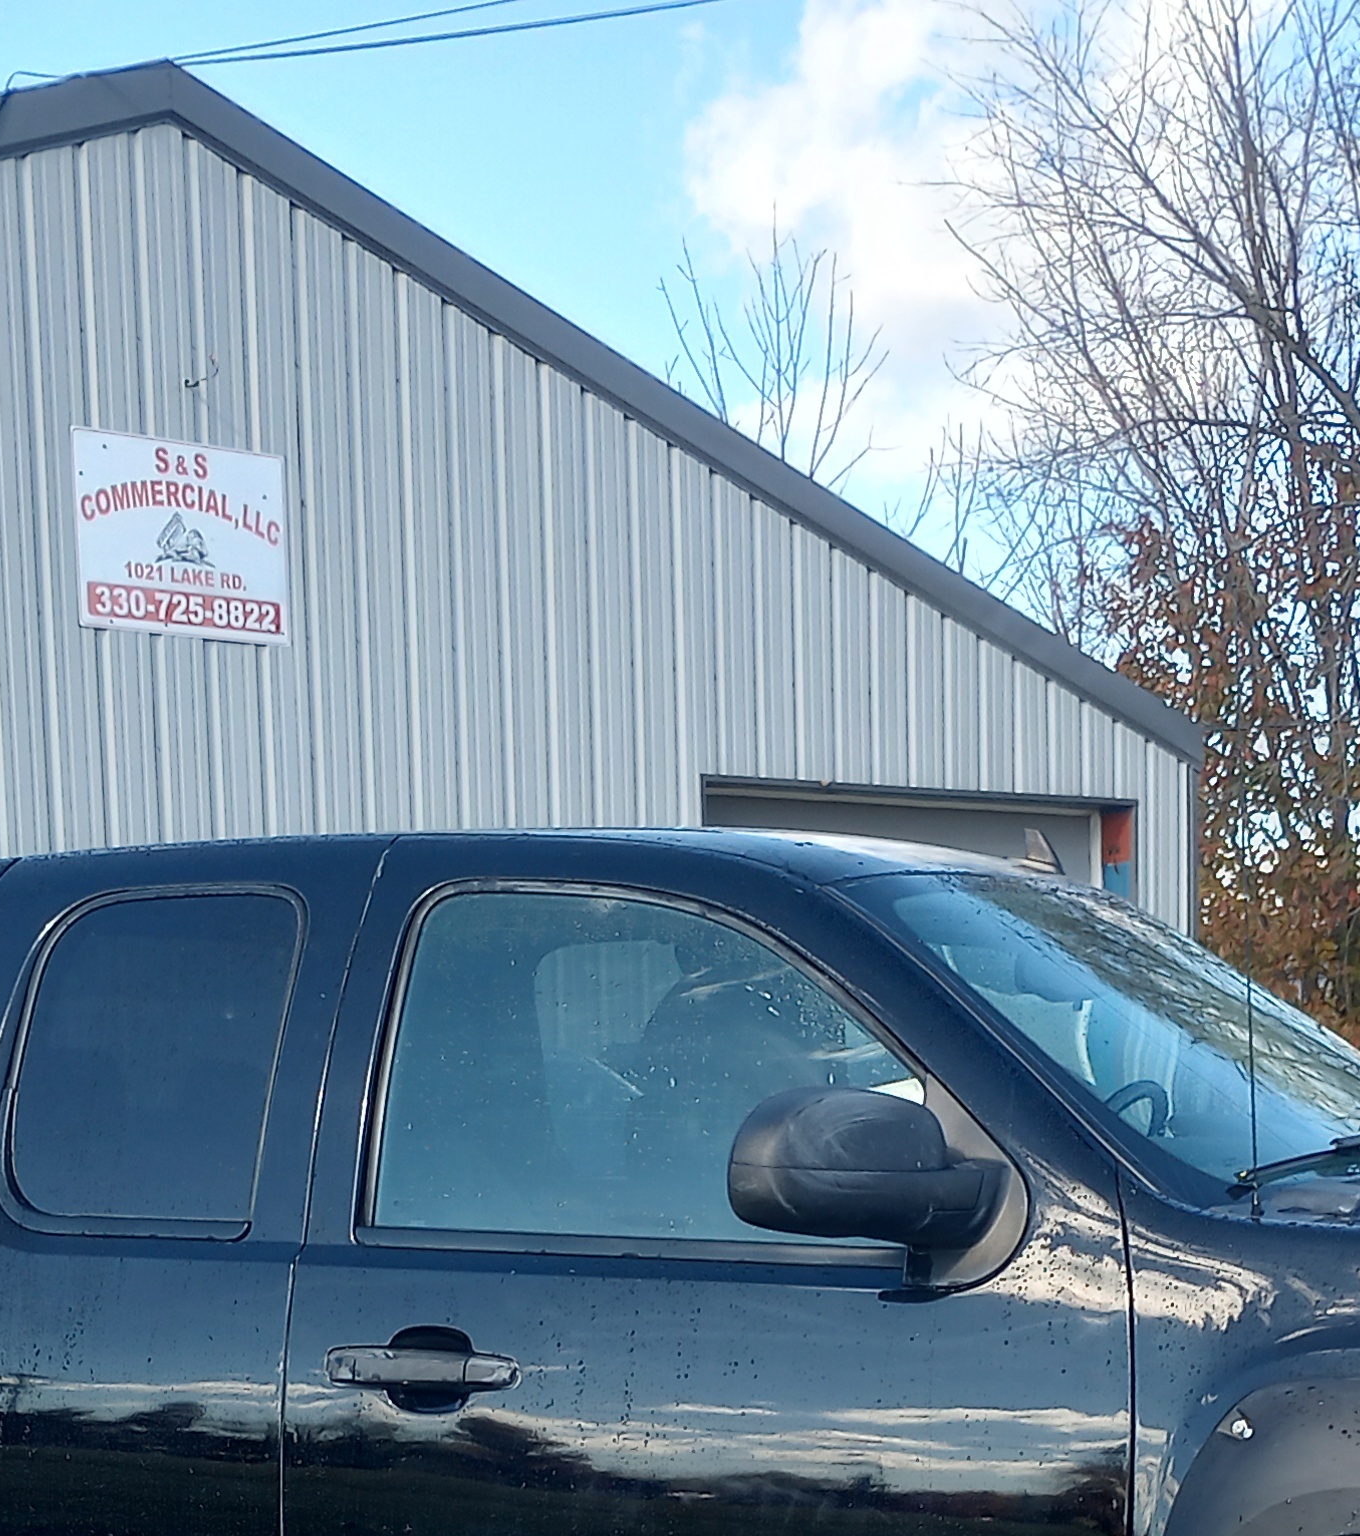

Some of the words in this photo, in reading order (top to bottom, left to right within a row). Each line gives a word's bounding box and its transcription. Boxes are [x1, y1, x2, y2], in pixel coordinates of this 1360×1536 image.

[155, 447, 170, 474] S
[175, 455, 188, 476] &
[193, 453, 208, 480] S
[124, 561, 163, 582] 1021
[170, 566, 215, 588] LAKE
[220, 572, 247, 592] RD.
[95, 586, 277, 633] 330-725-8822
